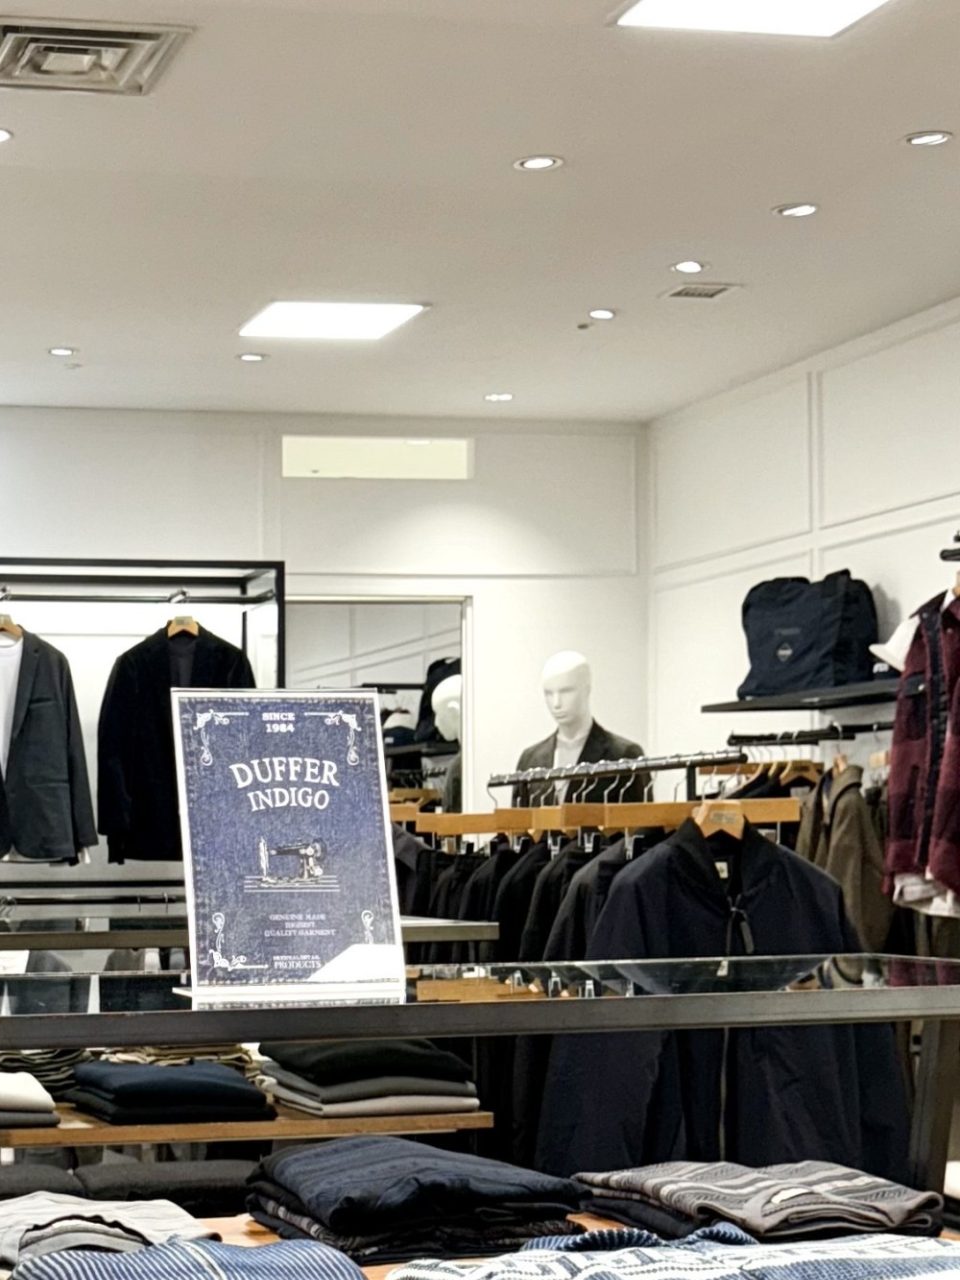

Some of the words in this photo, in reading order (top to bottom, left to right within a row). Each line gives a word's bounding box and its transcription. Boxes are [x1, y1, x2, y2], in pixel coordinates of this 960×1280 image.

[262, 712, 295, 721] SINCE
[265, 723, 295, 733] 1984
[229, 757, 339, 788] DUFFER
[247, 787, 330, 812] INDIGO
[273, 961, 322, 970] PRODUCTS
